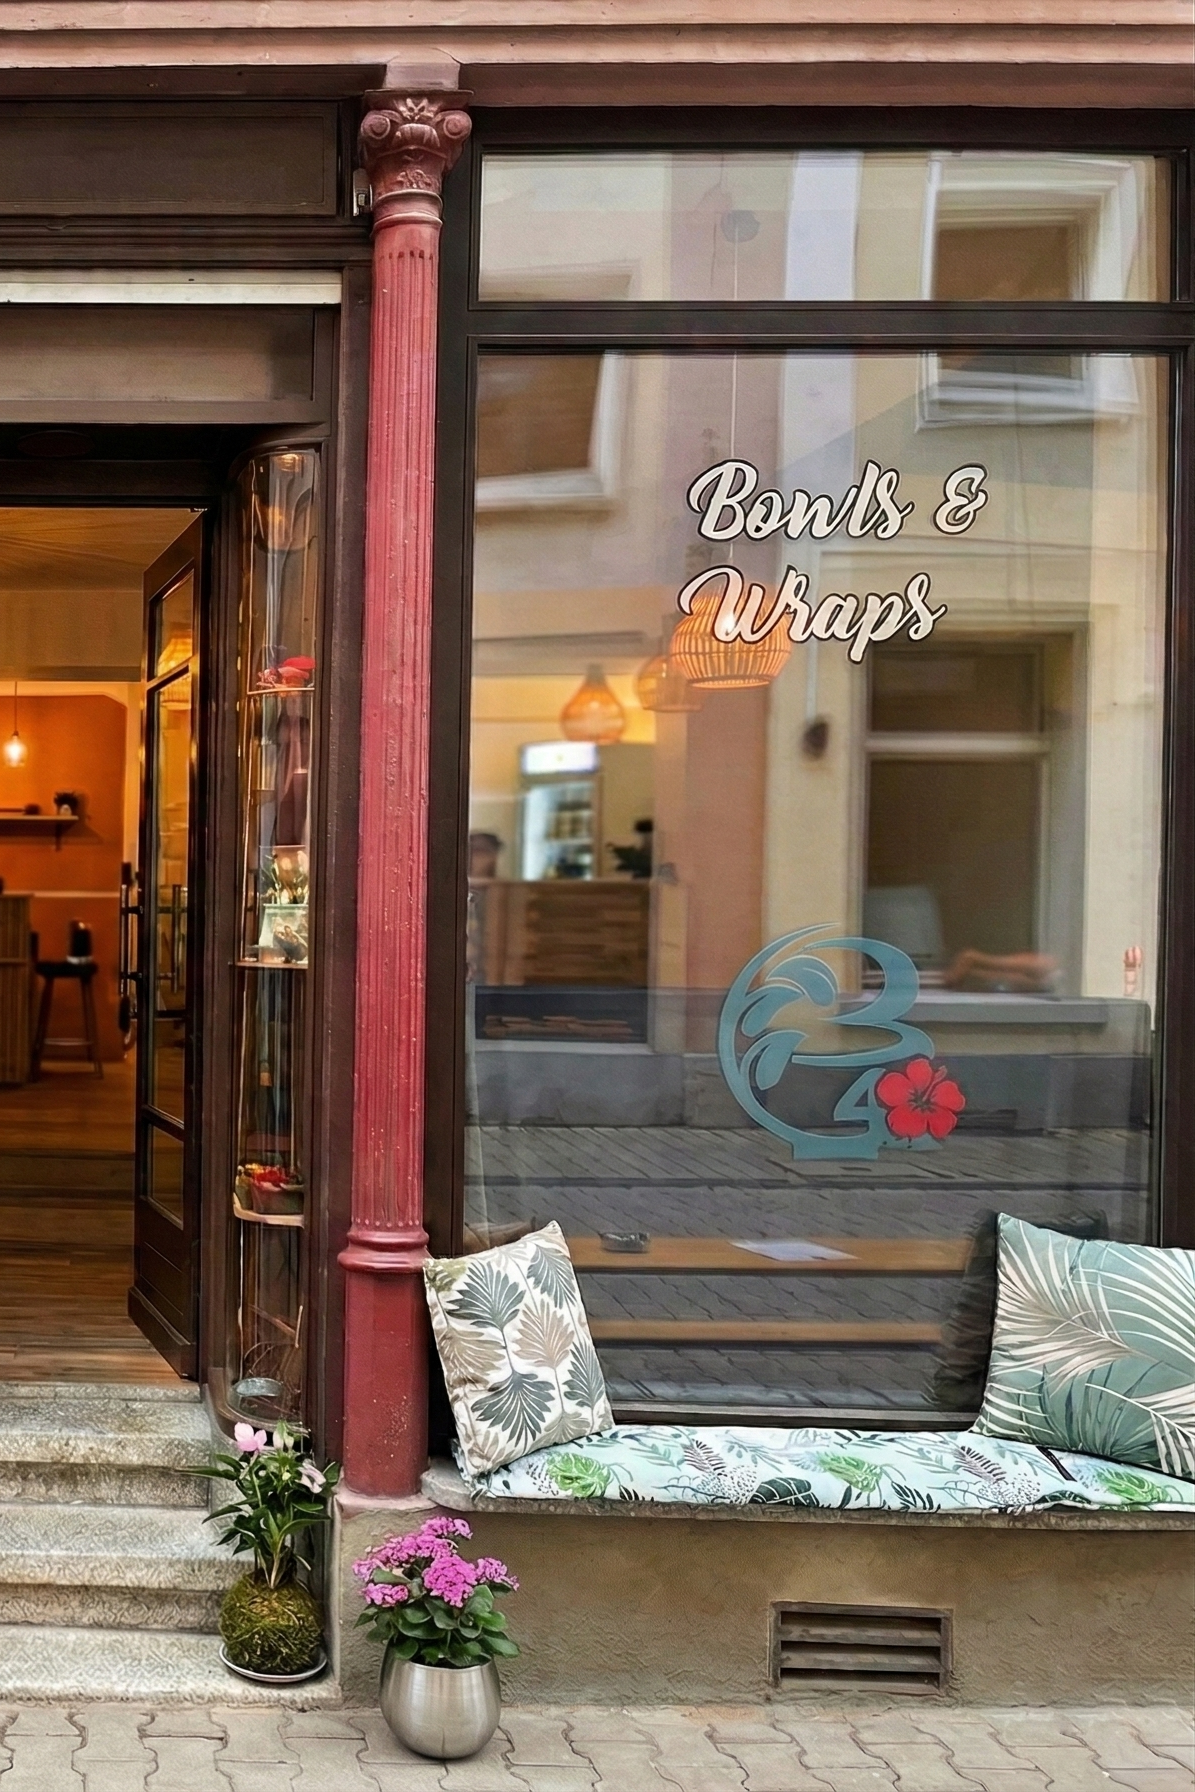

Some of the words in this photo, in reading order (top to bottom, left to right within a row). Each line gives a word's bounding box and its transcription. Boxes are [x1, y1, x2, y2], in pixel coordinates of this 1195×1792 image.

[687, 459, 915, 541] Bowls
[934, 463, 989, 535] &
[678, 564, 948, 664] Wraps
